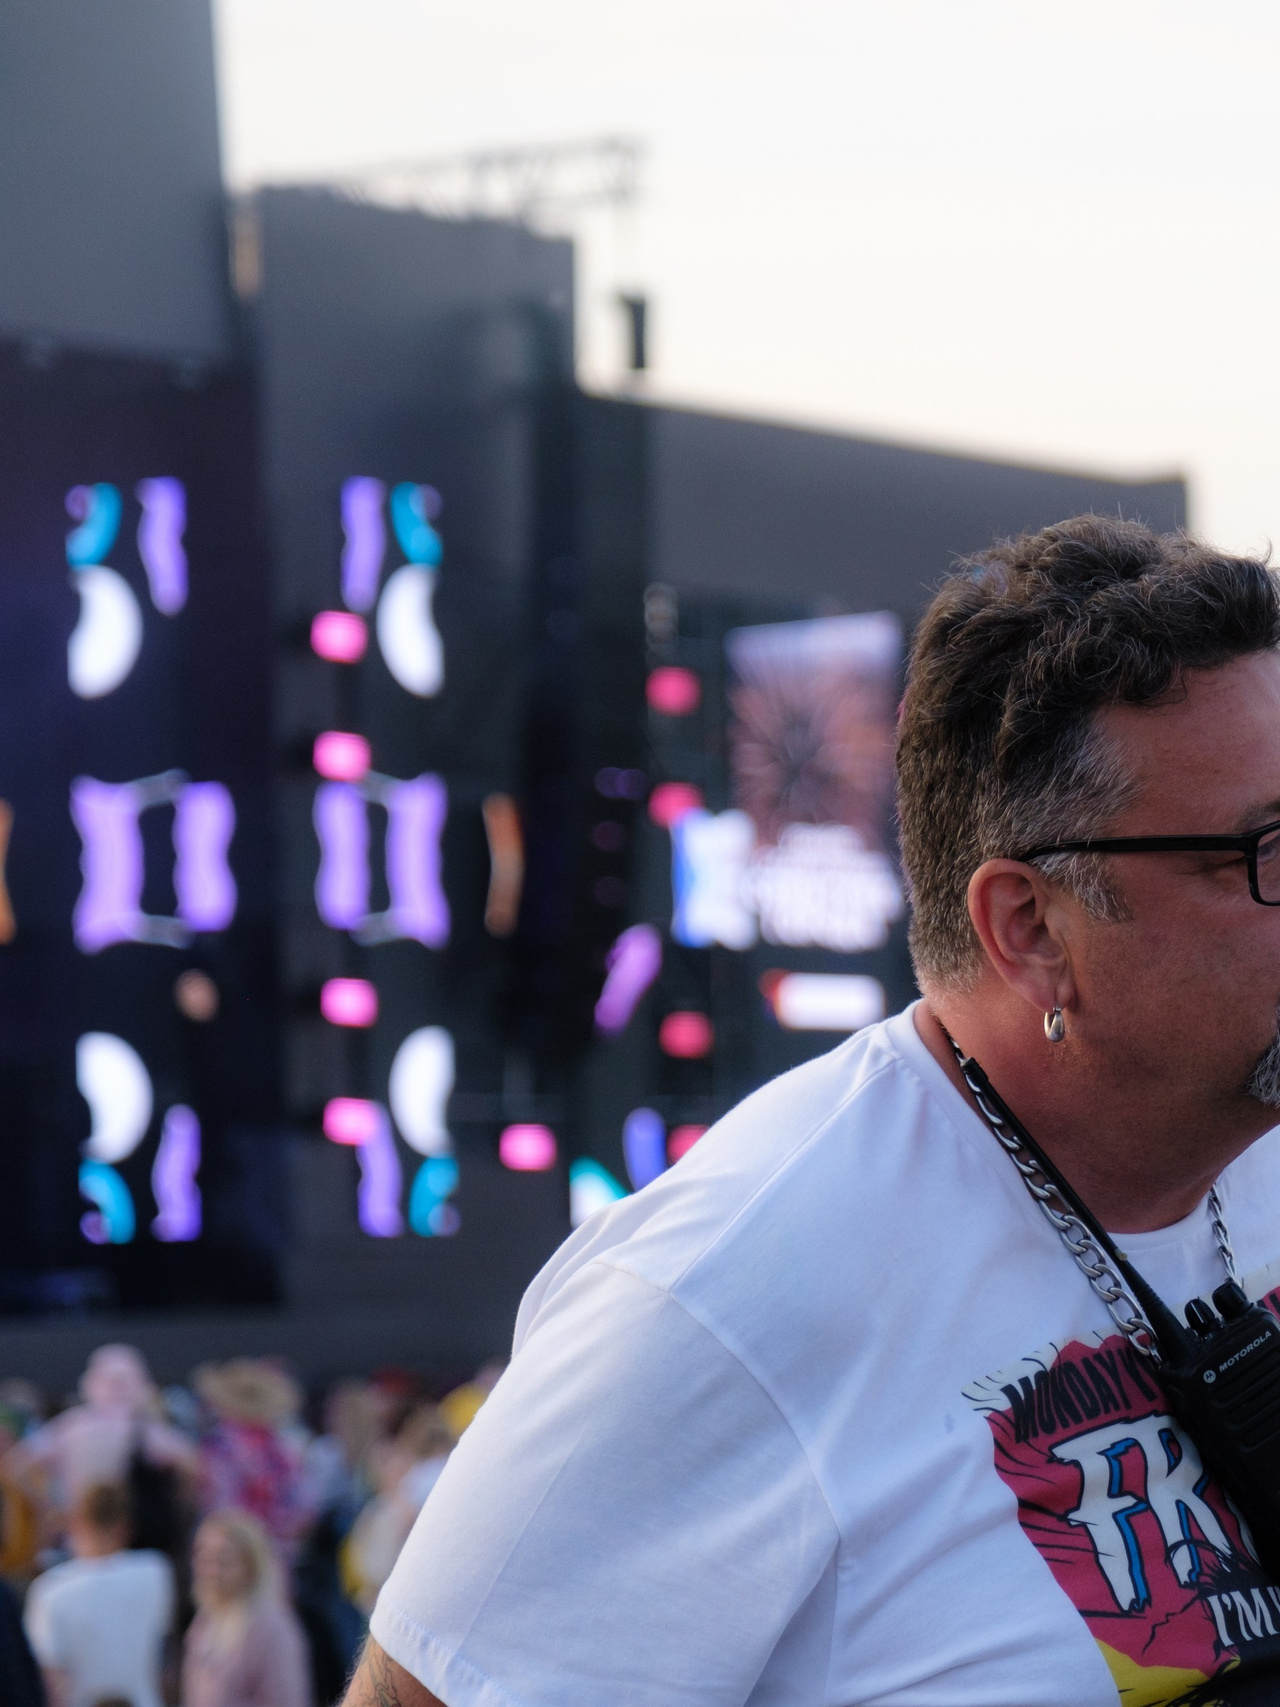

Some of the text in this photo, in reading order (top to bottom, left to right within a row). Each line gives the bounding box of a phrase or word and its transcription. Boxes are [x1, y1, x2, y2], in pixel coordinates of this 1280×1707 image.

[1218, 1330, 1272, 1373] MOTOROLA
[1000, 1349, 1132, 1443] MONDAY
[1207, 1587, 1280, 1647] I'M
